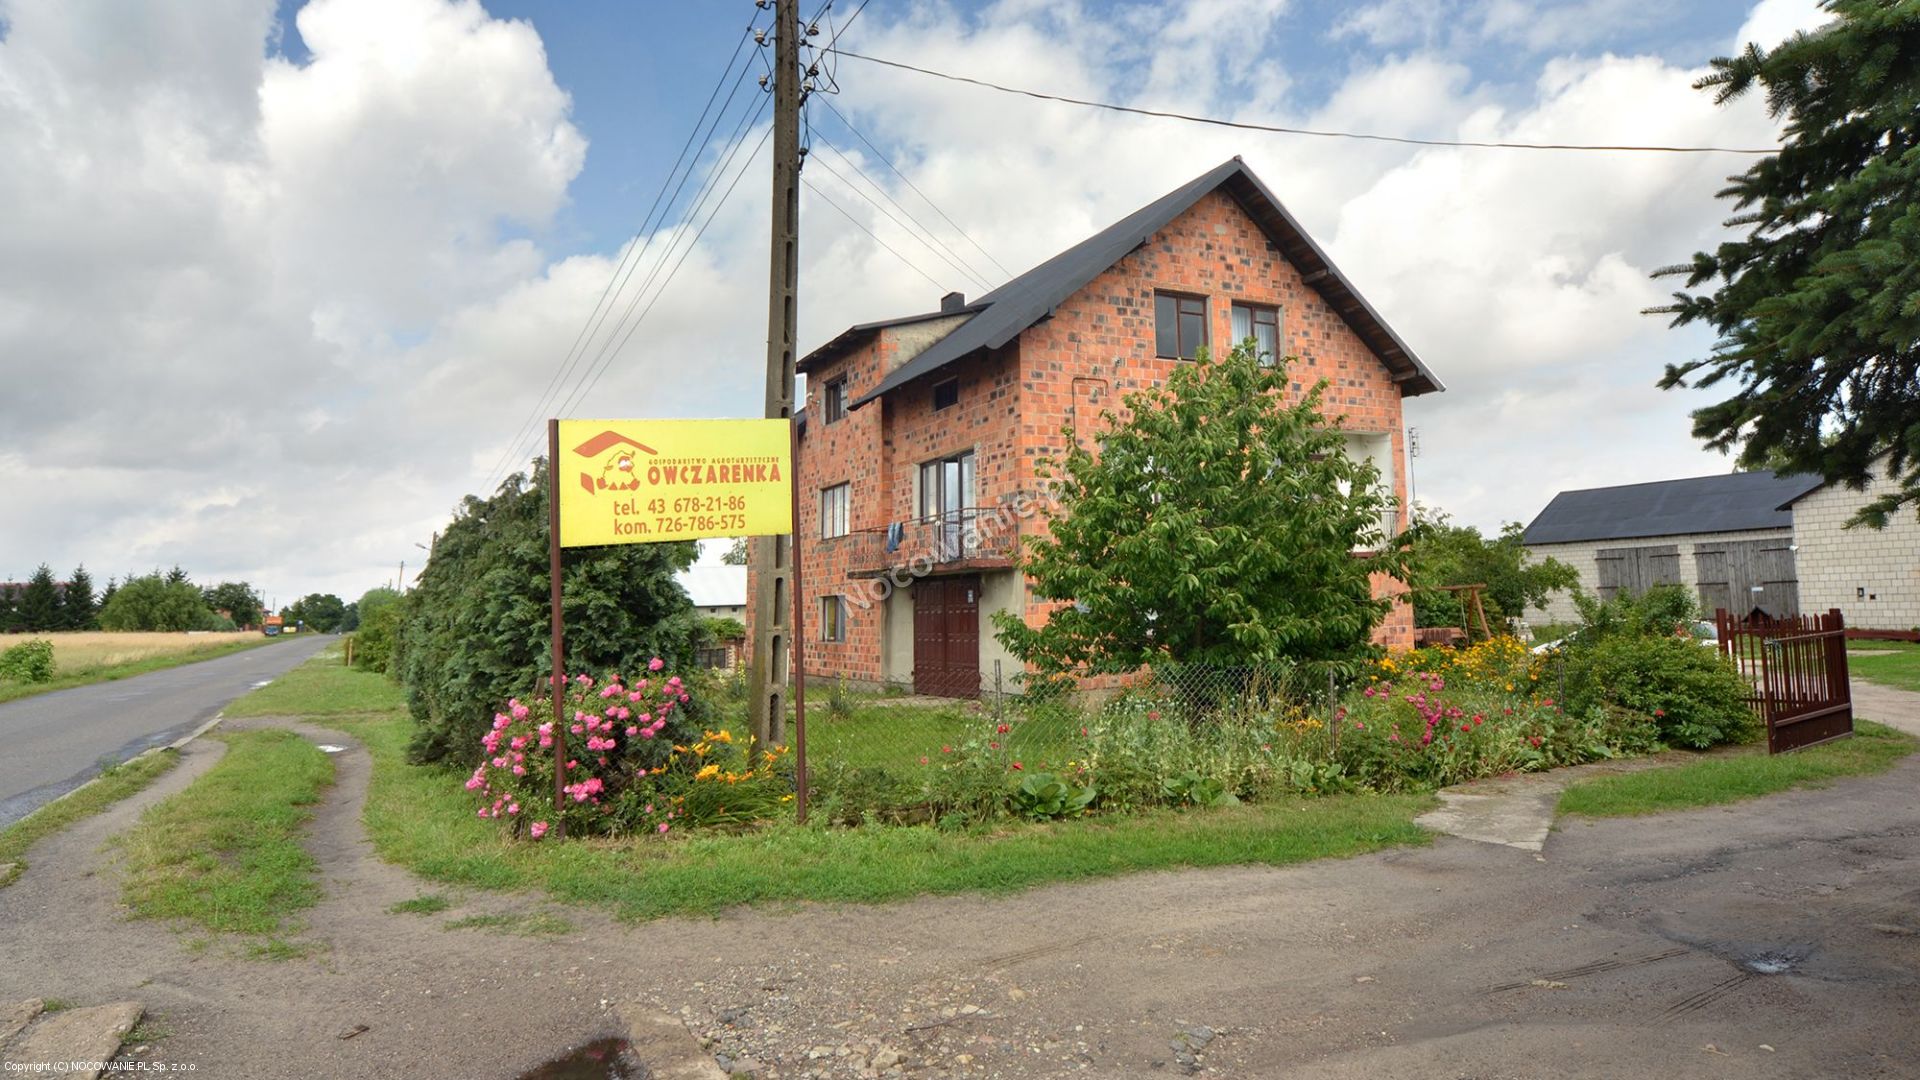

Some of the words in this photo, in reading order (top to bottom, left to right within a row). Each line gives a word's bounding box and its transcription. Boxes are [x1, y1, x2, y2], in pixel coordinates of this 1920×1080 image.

[647, 463, 781, 485] OWCZARENKA
[614, 498, 640, 515] tel.
[648, 498, 666, 514] 43
[674, 495, 746, 513] 678-21-86
[614, 518, 652, 535] kom.
[656, 514, 746, 533] 726-786-575
